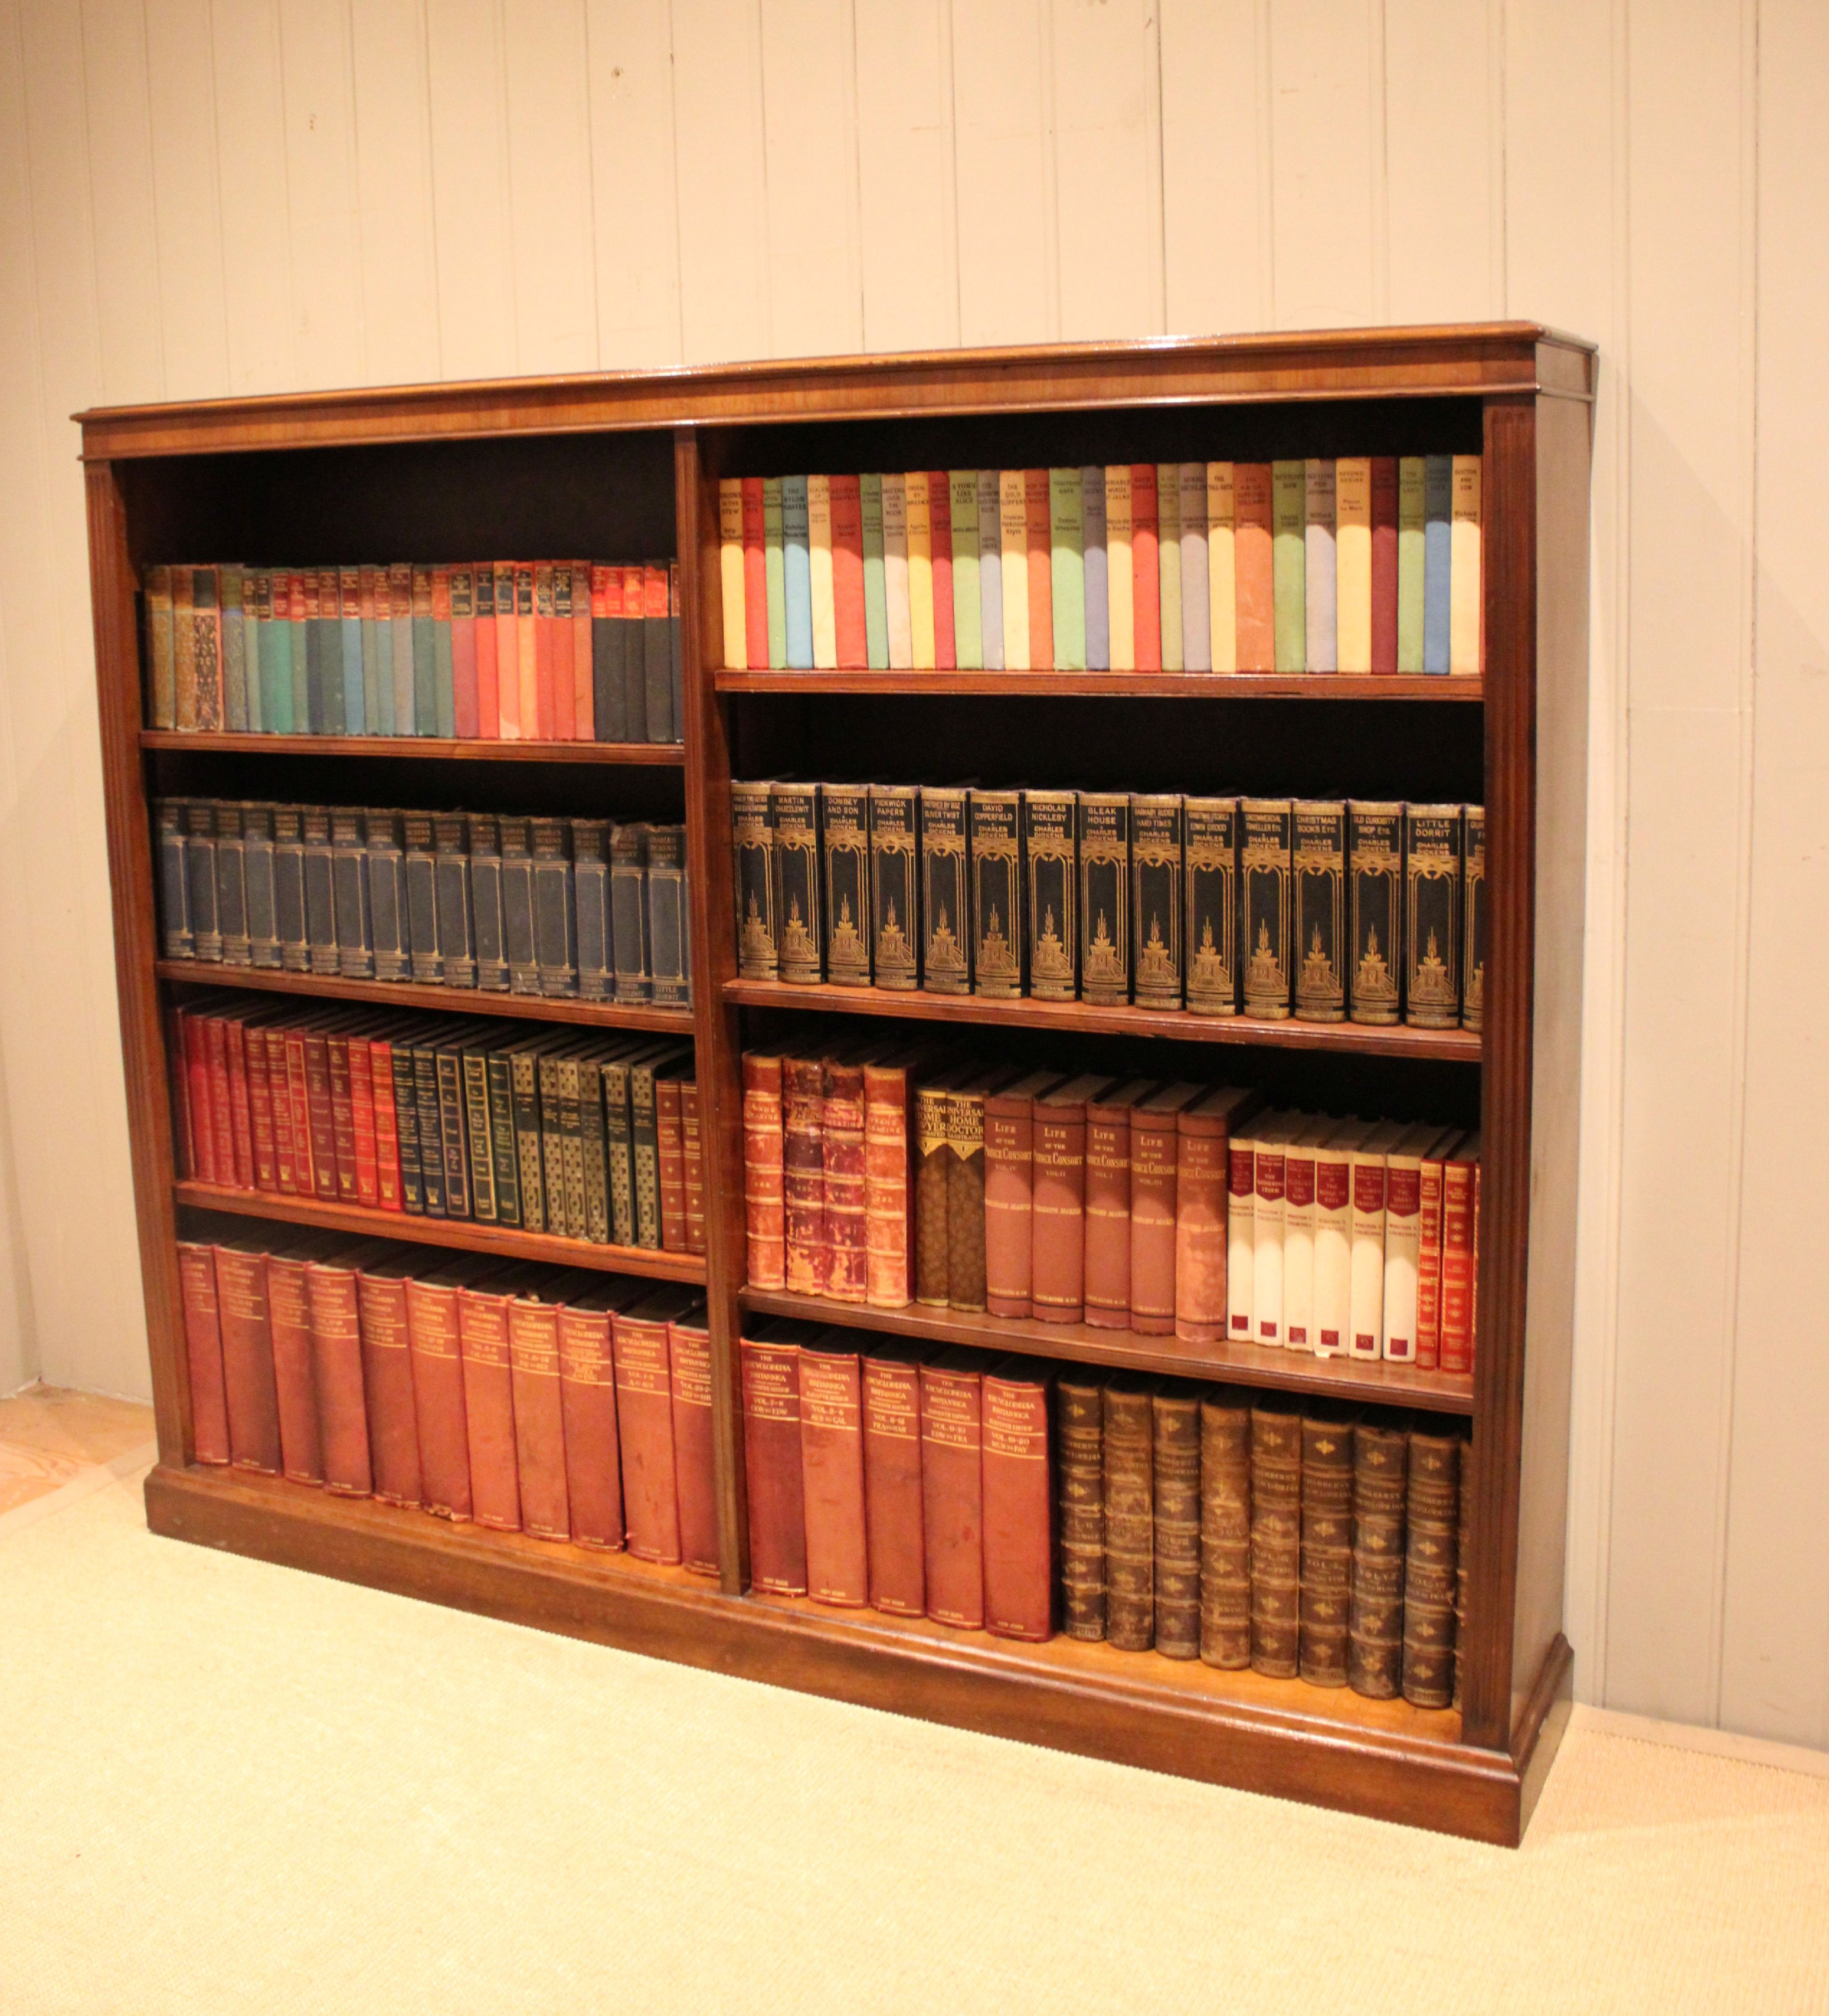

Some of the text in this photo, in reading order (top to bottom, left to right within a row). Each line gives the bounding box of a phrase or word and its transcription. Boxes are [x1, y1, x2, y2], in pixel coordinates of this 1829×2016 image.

[875, 799, 906, 807] PICKWICK
[975, 813, 1013, 821] COPPERFIELD
[1032, 814, 1067, 822] NICKLEBY
[1297, 816, 1337, 825] CHRISTMAS
[1298, 825, 1320, 833] BOOKS
[1417, 820, 1451, 828] LITTLE
[1416, 829, 1451, 837] DORRIT
[950, 1115, 979, 1125] HOME
[947, 1123, 984, 1135] DOCTOR
[1044, 1127, 1066, 1138] LIFE
[1093, 1128, 1115, 1141] LIFE
[1141, 1135, 1163, 1147] LIFE
[1003, 1147, 1032, 1160] CONSORT
[1053, 1152, 1082, 1165] CONSORT
[1148, 1162, 1176, 1175] CONSOR
[809, 1379, 846, 1391] BRITANNICA
[871, 1387, 907, 1400] BRITANNICA
[1003, 1391, 1015, 1399] THE
[930, 1395, 967, 1408] BRITANNICA
[992, 1405, 1030, 1419] BRITANNICA
